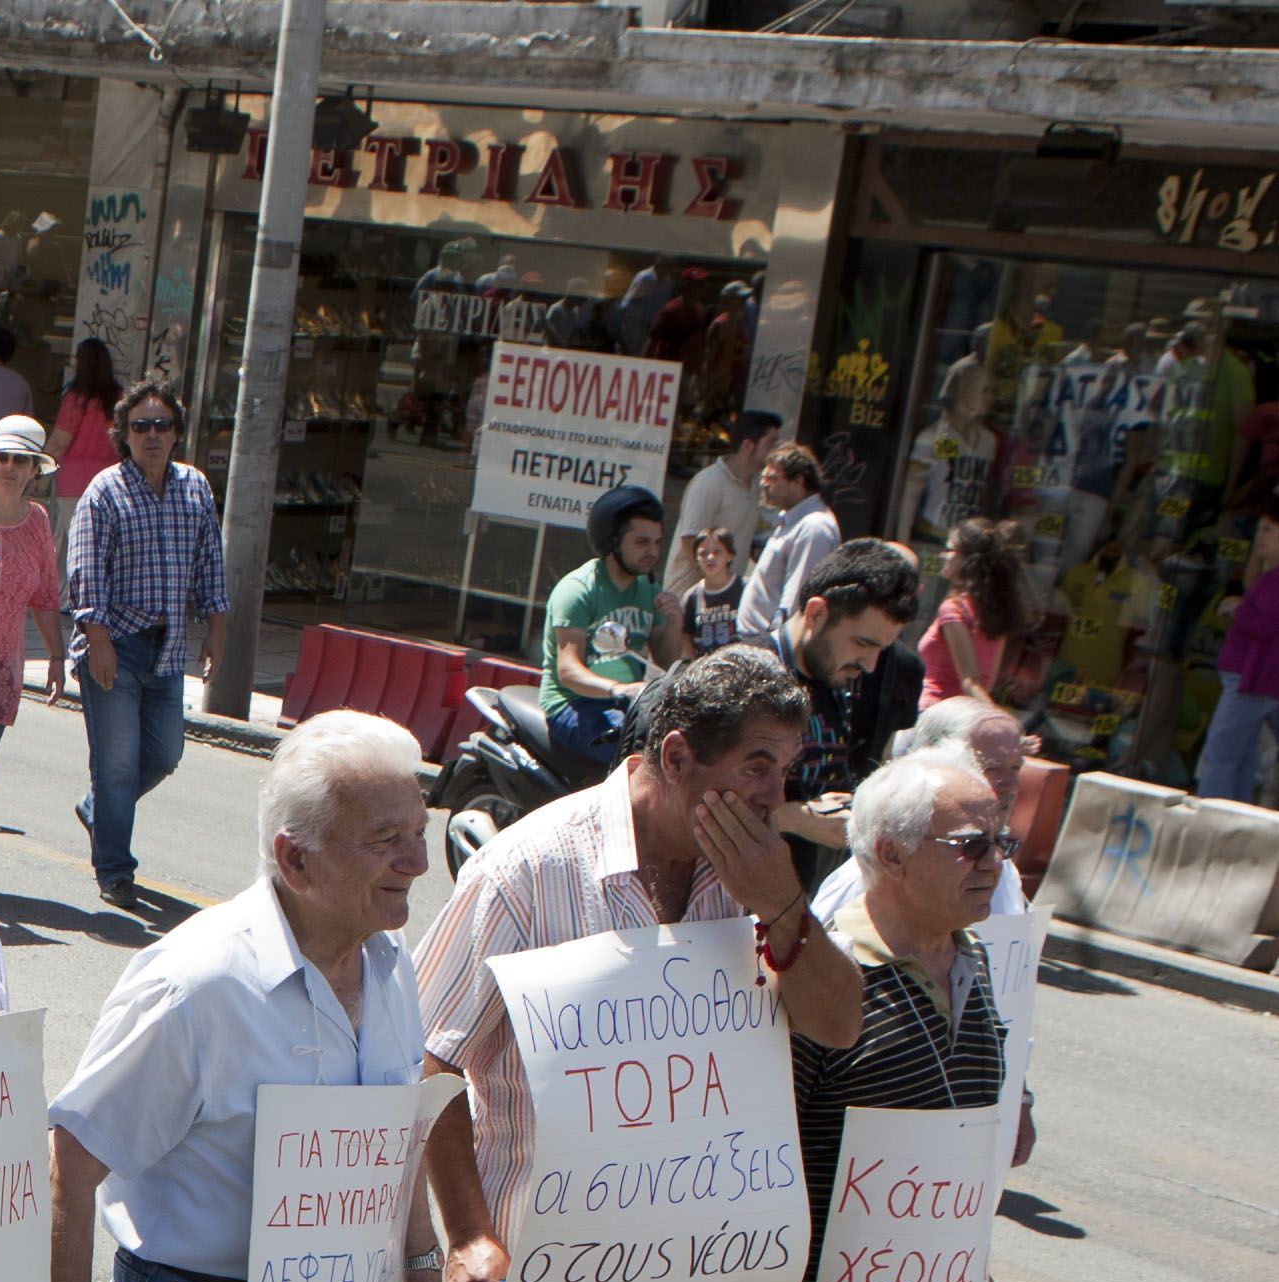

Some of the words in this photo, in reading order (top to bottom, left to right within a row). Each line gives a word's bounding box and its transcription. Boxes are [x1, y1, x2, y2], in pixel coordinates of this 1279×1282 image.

[493, 352, 674, 427] ΞΕΠΟΥΛΑΜΕ
[511, 448, 632, 490] ΠΕΤΡΙΔΗΣ
[527, 492, 582, 515] ΕΓΝΑΤΙΑ
[521, 989, 587, 1055] Να
[564, 1050, 730, 1134] ΤΩΡΑ
[276, 1128, 324, 1170] ΓΙΑ
[330, 1127, 391, 1169] ΤΟΥΣ
[534, 1168, 572, 1218] οι
[586, 1131, 796, 1213] συντάξεις
[266, 1189, 332, 1229] ΔΕΝ
[837, 1155, 985, 1220] Κάτω
[687, 1219, 791, 1280] νέους
